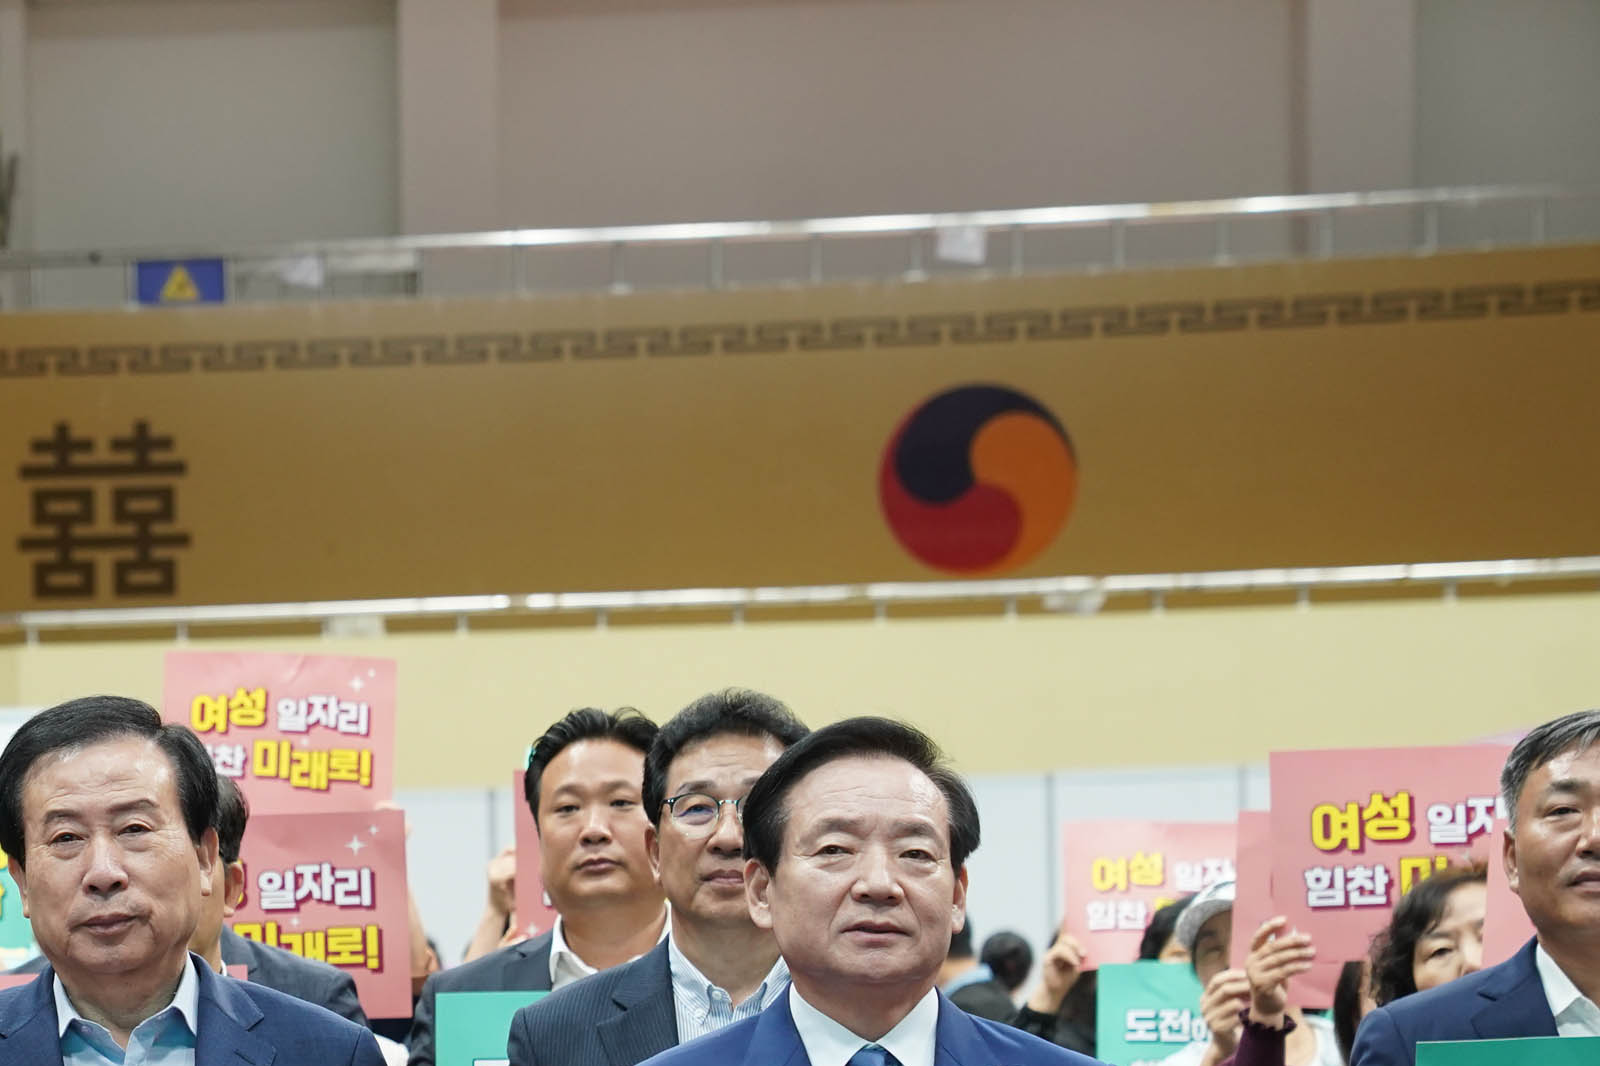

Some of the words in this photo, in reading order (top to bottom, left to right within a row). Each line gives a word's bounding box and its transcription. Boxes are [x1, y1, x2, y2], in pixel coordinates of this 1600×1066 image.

[190, 687, 269, 734] 여성
[276, 695, 371, 737] 일자리
[206, 743, 246, 777] 찬
[252, 738, 374, 791] 미래로!
[1311, 791, 1413, 852] 여성
[1426, 796, 1508, 845] 일자
[257, 861, 374, 911] 일자리
[1091, 850, 1165, 893] 여성
[1303, 863, 1391, 908] 힘찬
